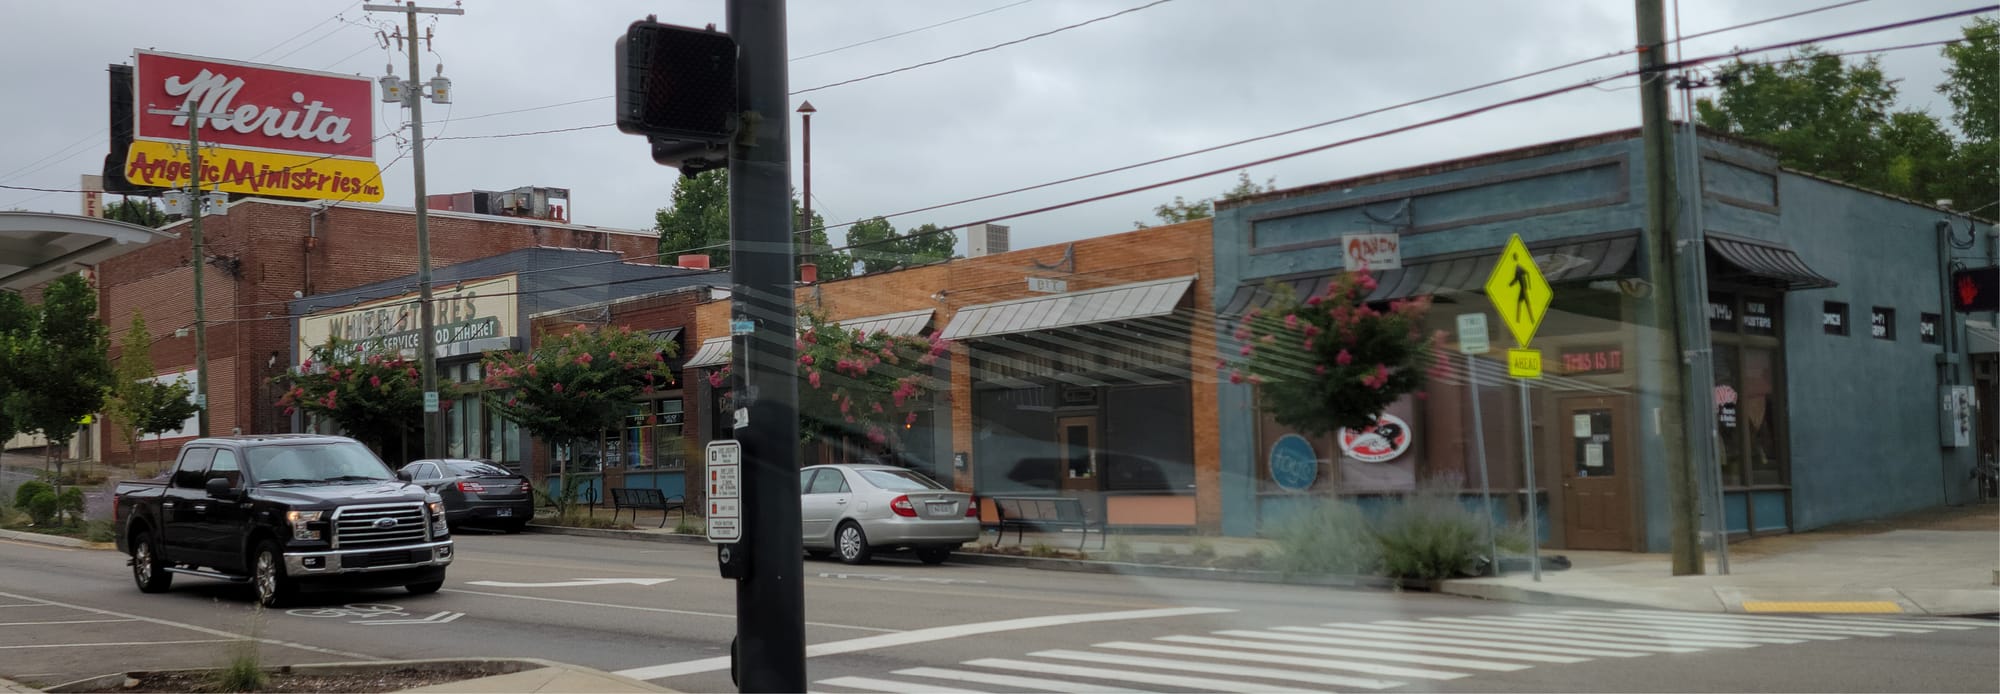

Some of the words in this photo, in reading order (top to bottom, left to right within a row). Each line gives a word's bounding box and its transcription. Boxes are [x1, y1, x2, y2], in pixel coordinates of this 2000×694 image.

[164, 68, 352, 144] Merita
[222, 158, 361, 193] Ministries
[454, 320, 494, 341] MARKET
[1514, 357, 1538, 371] AHEAD
[1563, 353, 1592, 371] THIS
[1595, 352, 1606, 370] IS
[1610, 351, 1621, 369] IT
